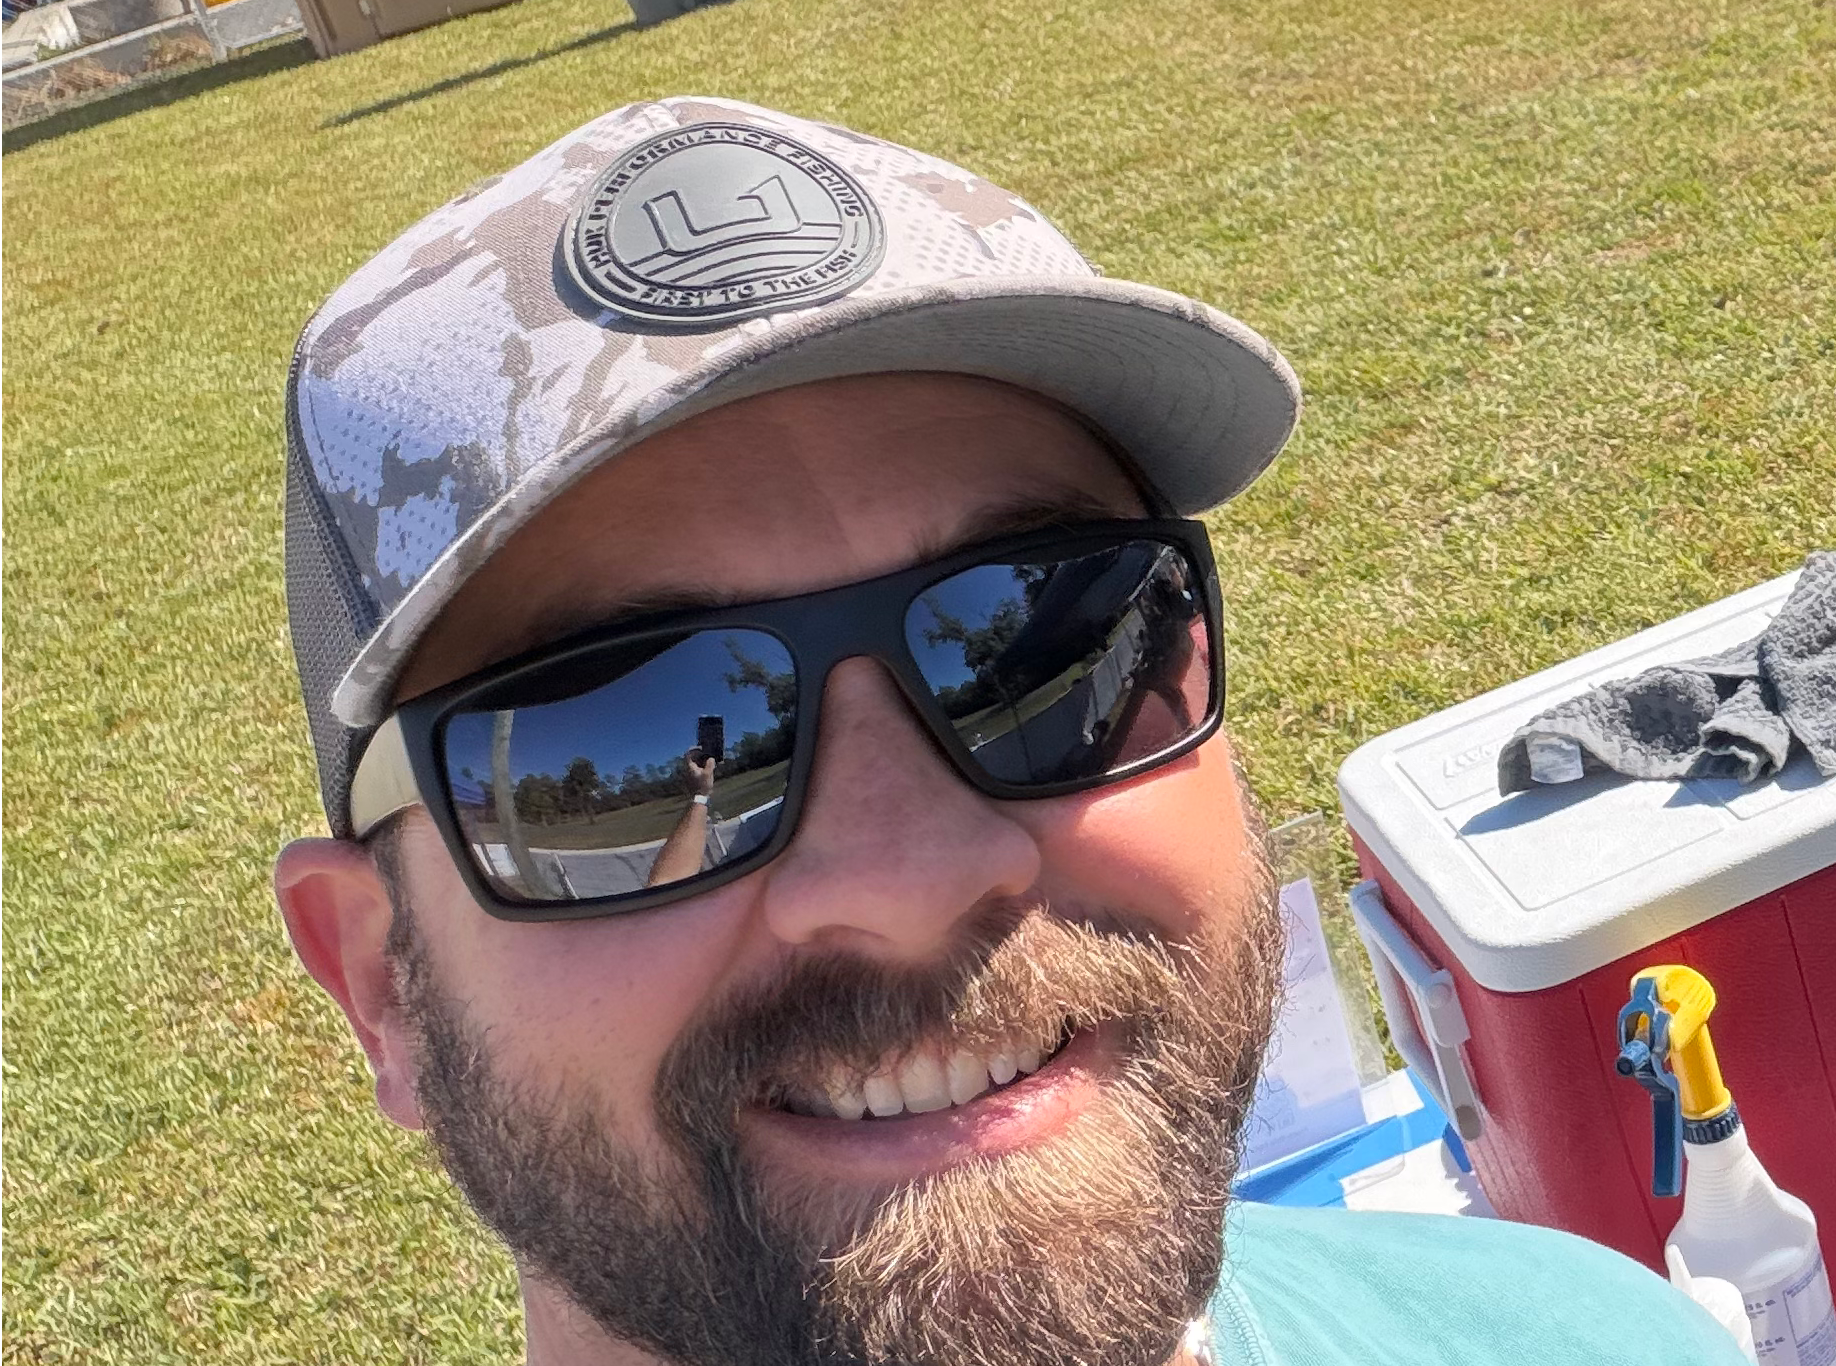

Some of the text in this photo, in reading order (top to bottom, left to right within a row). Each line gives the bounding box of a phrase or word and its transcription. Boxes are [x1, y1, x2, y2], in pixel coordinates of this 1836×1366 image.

[786, 147, 865, 218] FISHING
[721, 283, 756, 303] TO
[762, 271, 818, 293] THE
[814, 248, 859, 280] FISH
